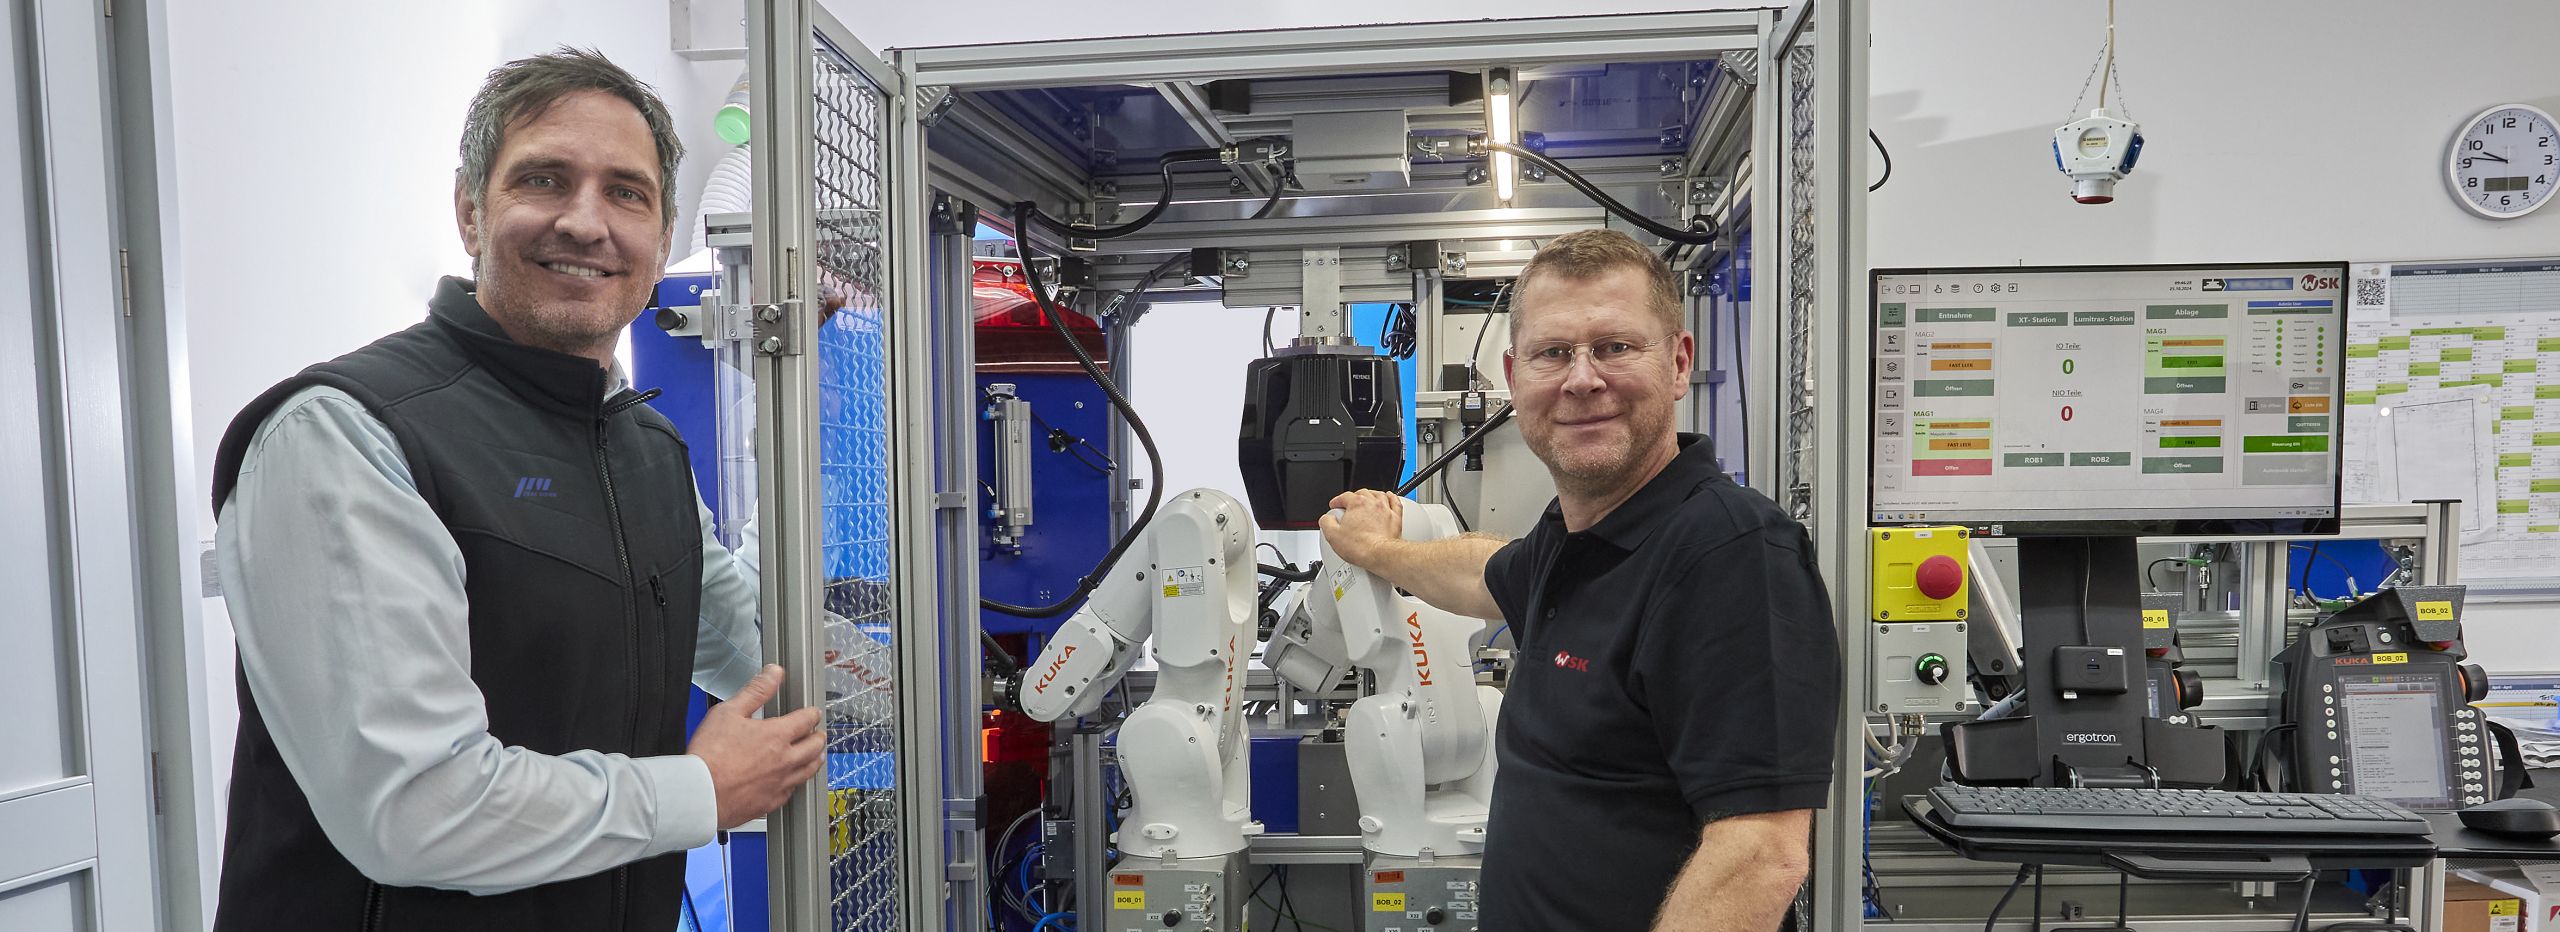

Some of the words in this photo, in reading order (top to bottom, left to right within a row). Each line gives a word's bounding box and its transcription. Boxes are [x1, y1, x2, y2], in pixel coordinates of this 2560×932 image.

[2502, 118, 2516, 128] 12
[2528, 122, 2533, 133] 1
[2486, 124, 2494, 135] 11
[2468, 140, 2483, 151] 10
[2538, 136, 2549, 147] 2
[2462, 158, 2472, 169] 9
[2544, 154, 2553, 165] 3
[2467, 177, 2478, 188] 8
[2534, 174, 2546, 185] 4
[2483, 193, 2490, 201] 7
[2500, 195, 2511, 206] 6
[2522, 192, 2530, 200] 5
[1938, 312, 1973, 320] Entnahme
[2174, 309, 2199, 317] Ablage
[2062, 359, 2075, 375] 0
[2060, 405, 2073, 421] 0
[2420, 607, 2448, 616] BOB_02
[2143, 616, 2165, 624] OB_01
[1407, 611, 1432, 686] KUKA
[2335, 657, 2369, 665] KUKA
[2376, 655, 2404, 663] BOB_02
[1035, 645, 1077, 695] KUKA
[1224, 634, 1235, 712] KUKA
[2066, 733, 2116, 744] ergotron
[1376, 899, 1402, 907] BOB_02
